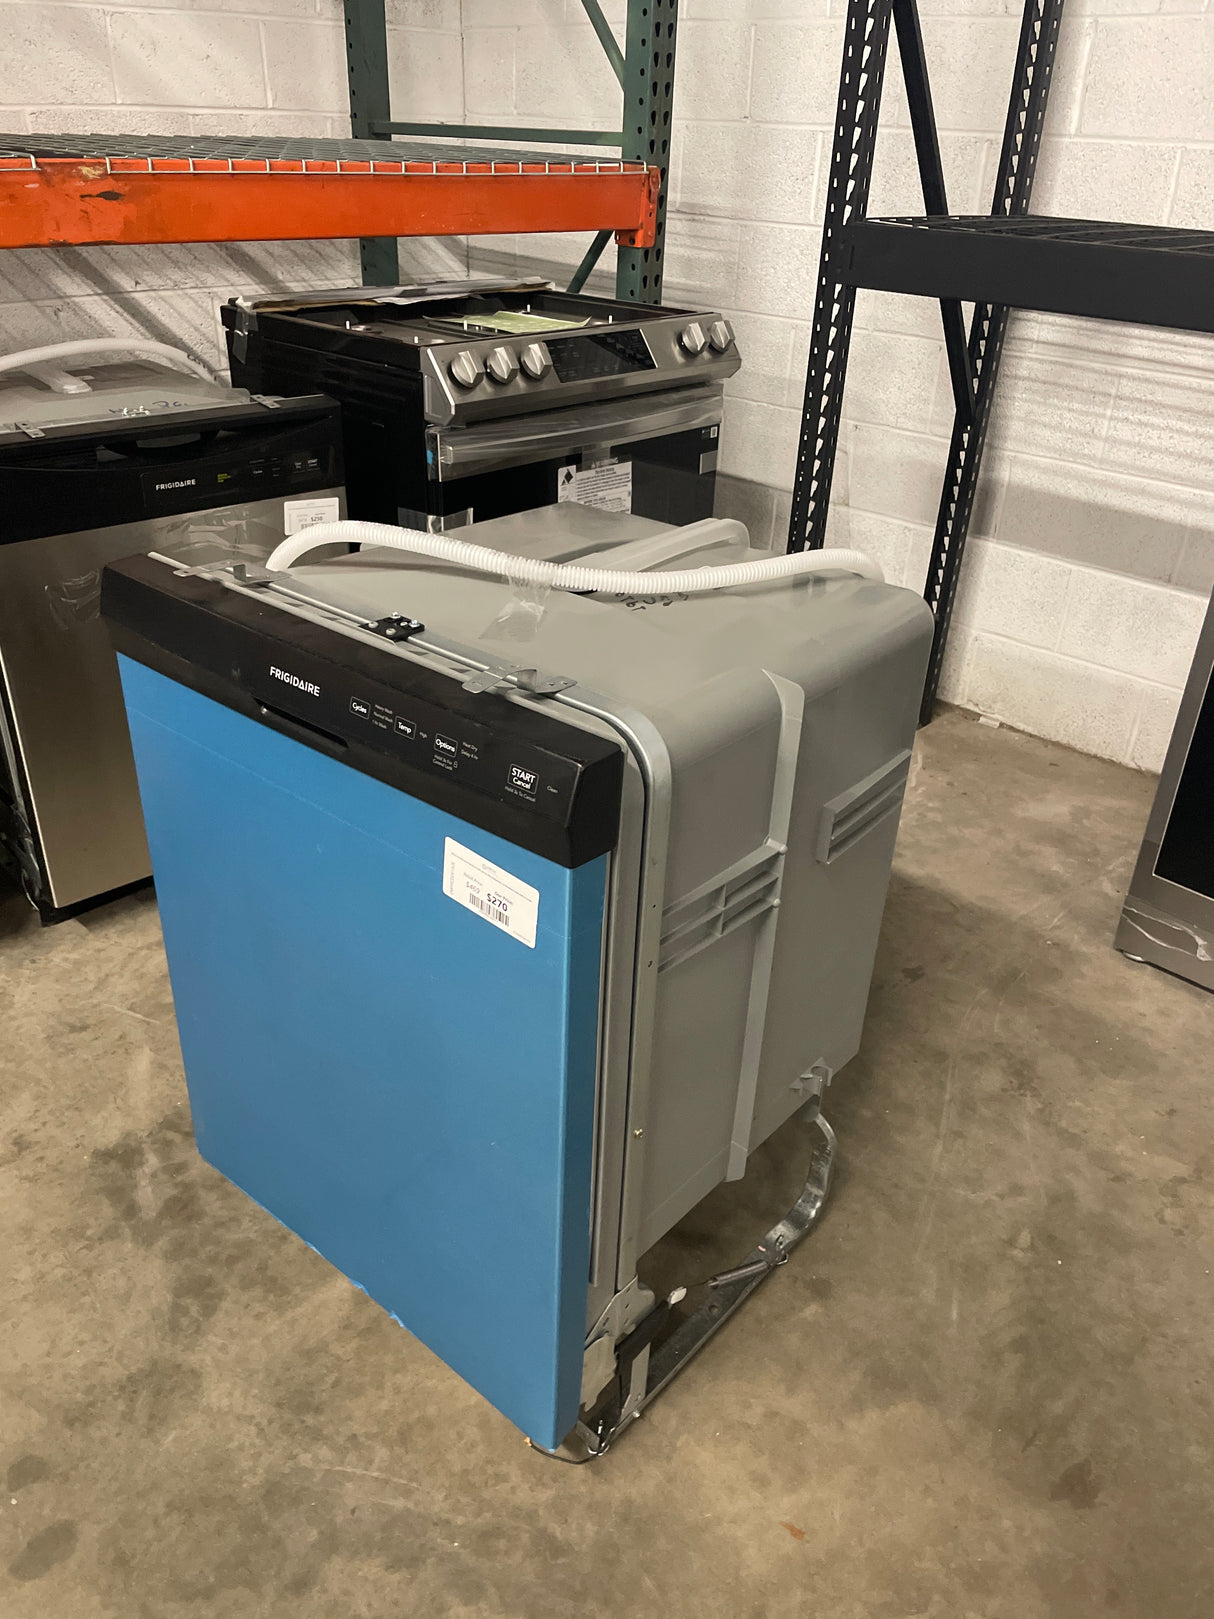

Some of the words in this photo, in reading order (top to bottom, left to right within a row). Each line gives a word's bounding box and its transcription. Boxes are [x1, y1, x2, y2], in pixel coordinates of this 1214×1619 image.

[155, 478, 196, 491] FRIGIDAIRE
[269, 665, 321, 697] FRIGIDAIRE
[398, 721, 412, 735] Temp
[435, 738, 456, 753] Options
[511, 767, 536, 784] START
[512, 776, 531, 790] Cancel
[486, 893, 508, 912] $270
